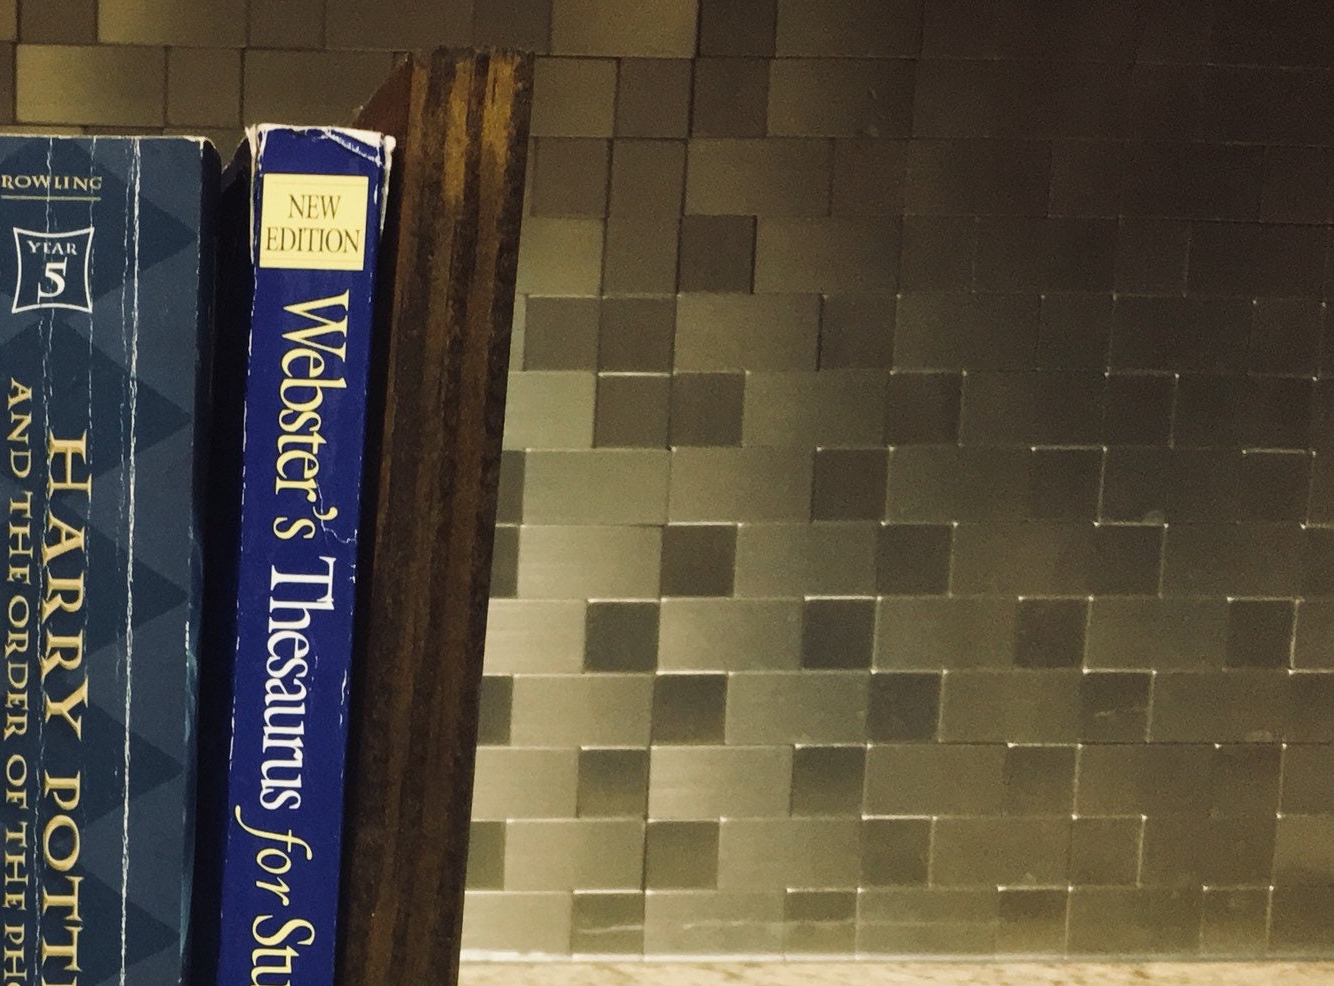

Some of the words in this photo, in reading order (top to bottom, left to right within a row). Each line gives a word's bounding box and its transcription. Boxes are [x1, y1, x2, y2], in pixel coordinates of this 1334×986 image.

[1, 174, 103, 191] ROWLING
[288, 194, 341, 220] NEW
[26, 240, 77, 255] YEAR
[37, 257, 68, 303] 5
[266, 227, 361, 254] EDITION
[7, 377, 33, 479] AND
[273, 289, 350, 540] Webster's
[7, 491, 34, 585] THE
[40, 428, 93, 742] HARRY
[3, 595, 30, 741] ORDER
[259, 556, 337, 810] Thesaurus
[4, 754, 29, 809] OF
[2, 821, 29, 911] THE
[235, 805, 313, 906] for
